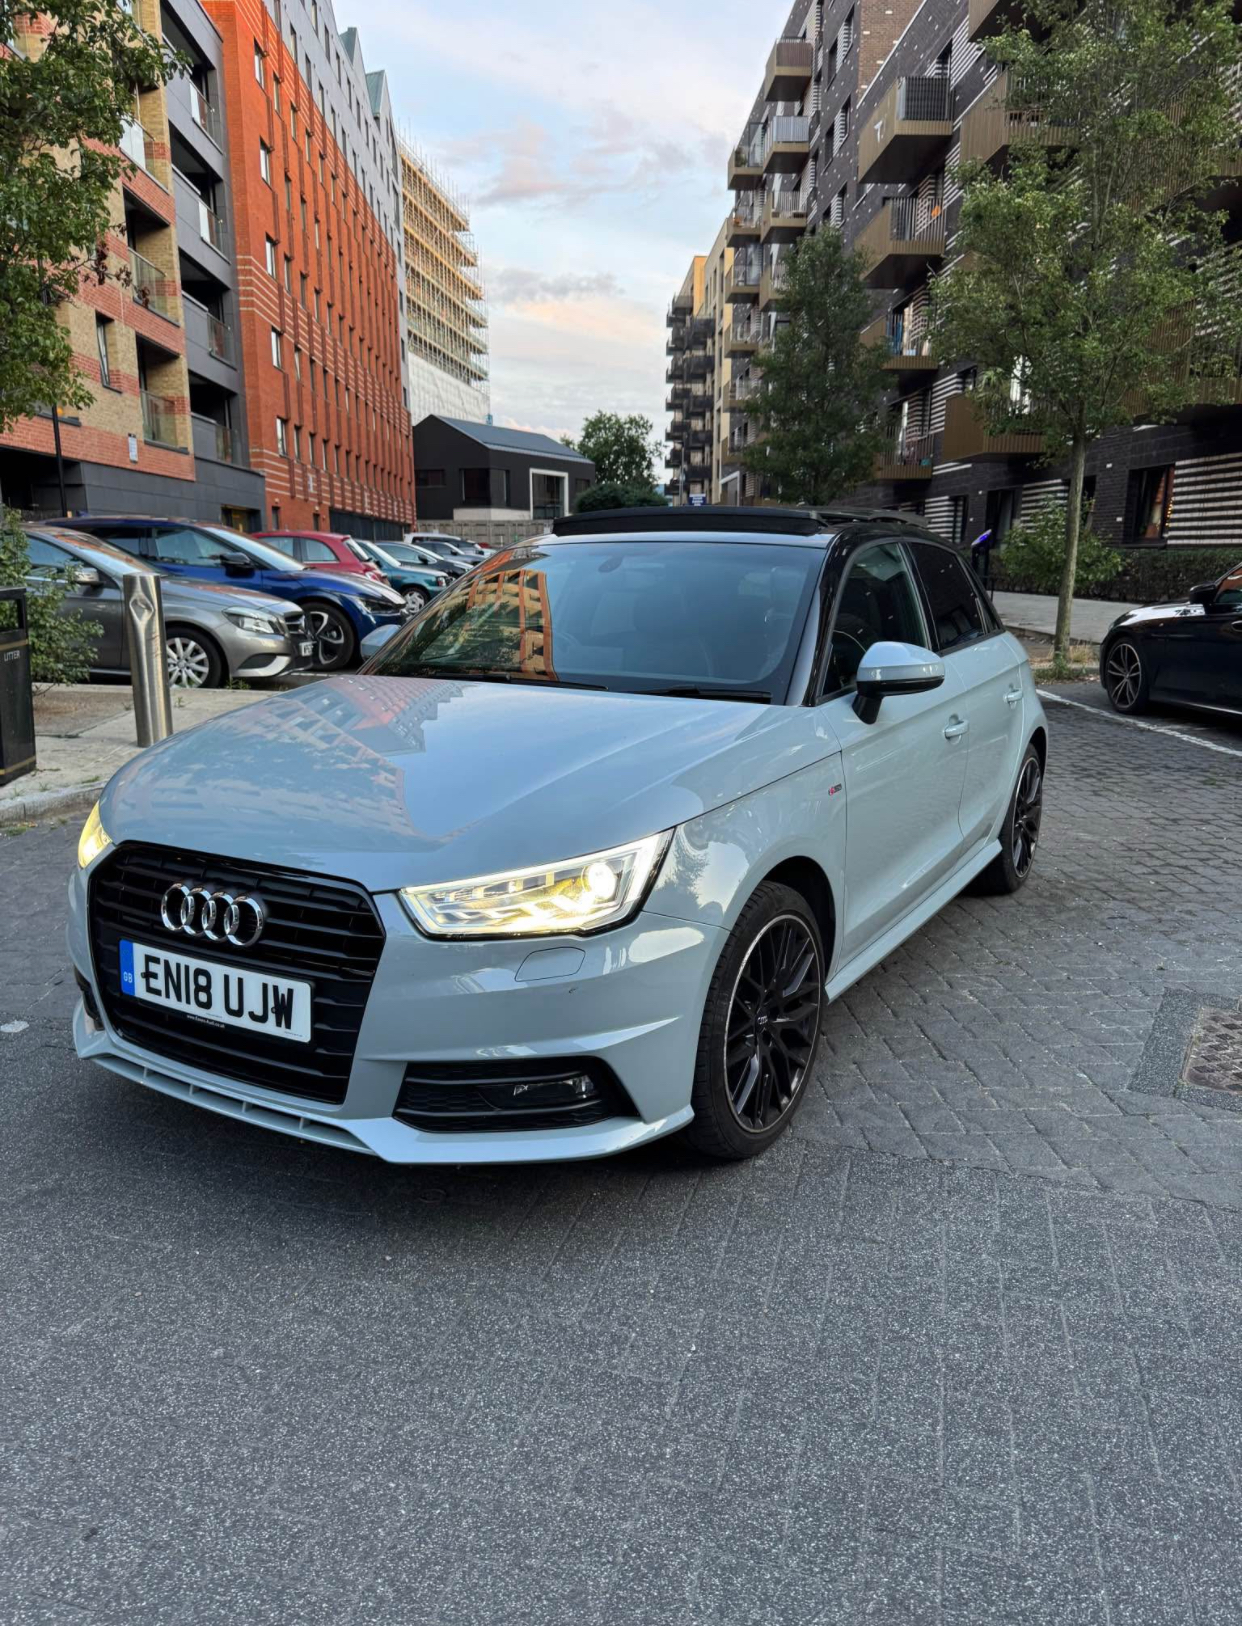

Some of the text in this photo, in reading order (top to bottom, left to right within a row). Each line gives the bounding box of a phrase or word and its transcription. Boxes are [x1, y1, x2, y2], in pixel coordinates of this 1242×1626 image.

[4, 650, 20, 662] LITTER
[123, 971, 133, 984] GB
[144, 954, 294, 1030] EN18 UJW
